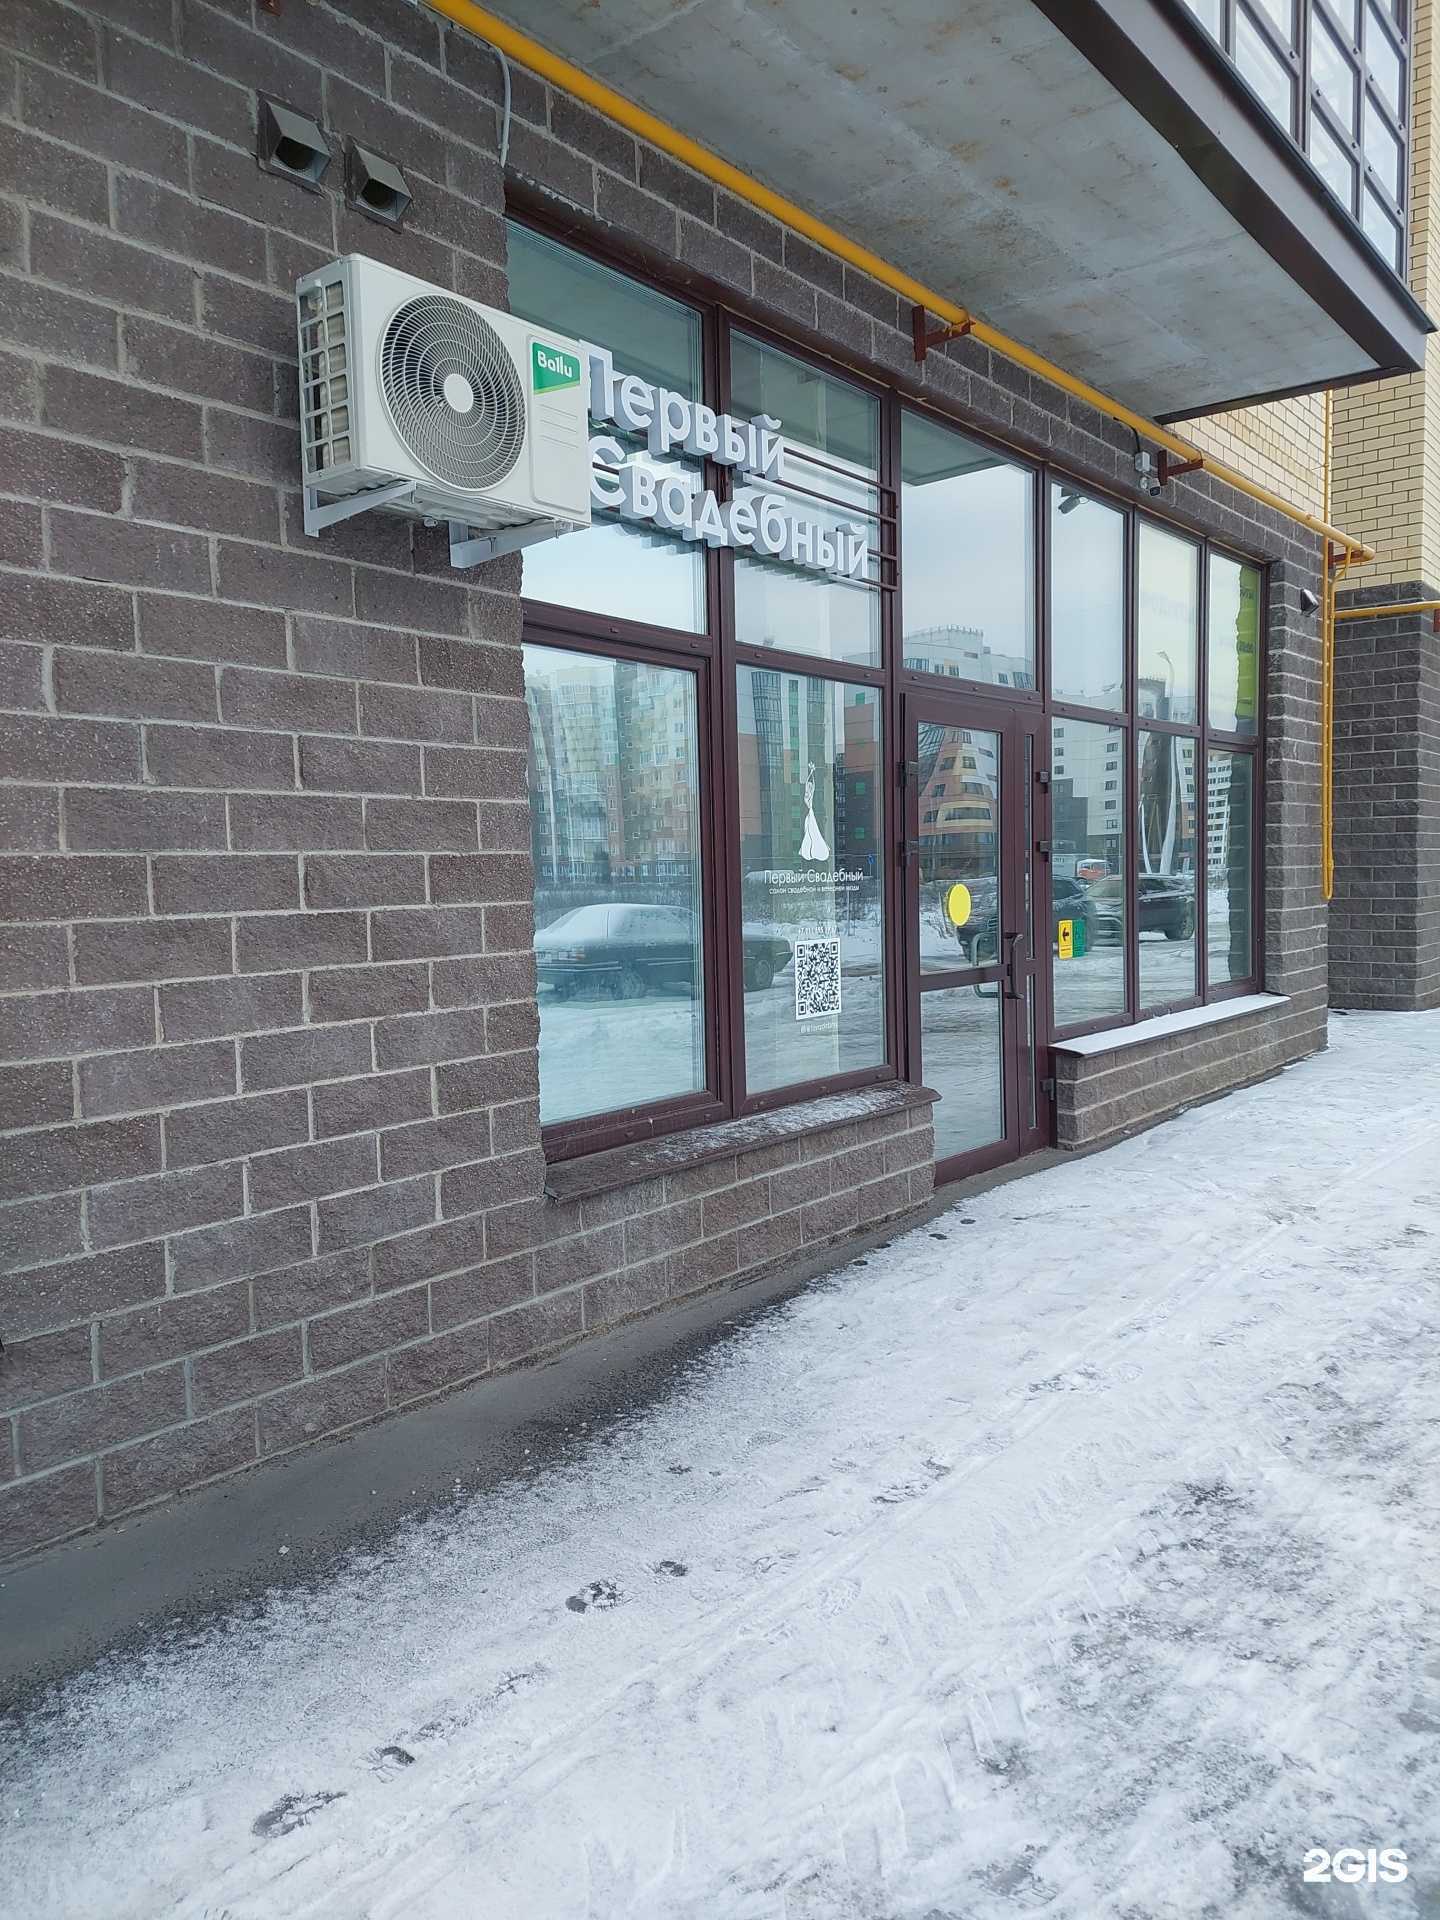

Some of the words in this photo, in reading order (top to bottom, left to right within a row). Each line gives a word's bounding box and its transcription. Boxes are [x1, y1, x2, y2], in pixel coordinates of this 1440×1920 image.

[537, 351, 573, 378] Ballu
[587, 435, 869, 581] Свадебный
[764, 869, 805, 887] Первый
[807, 867, 864, 883] Свадебный
